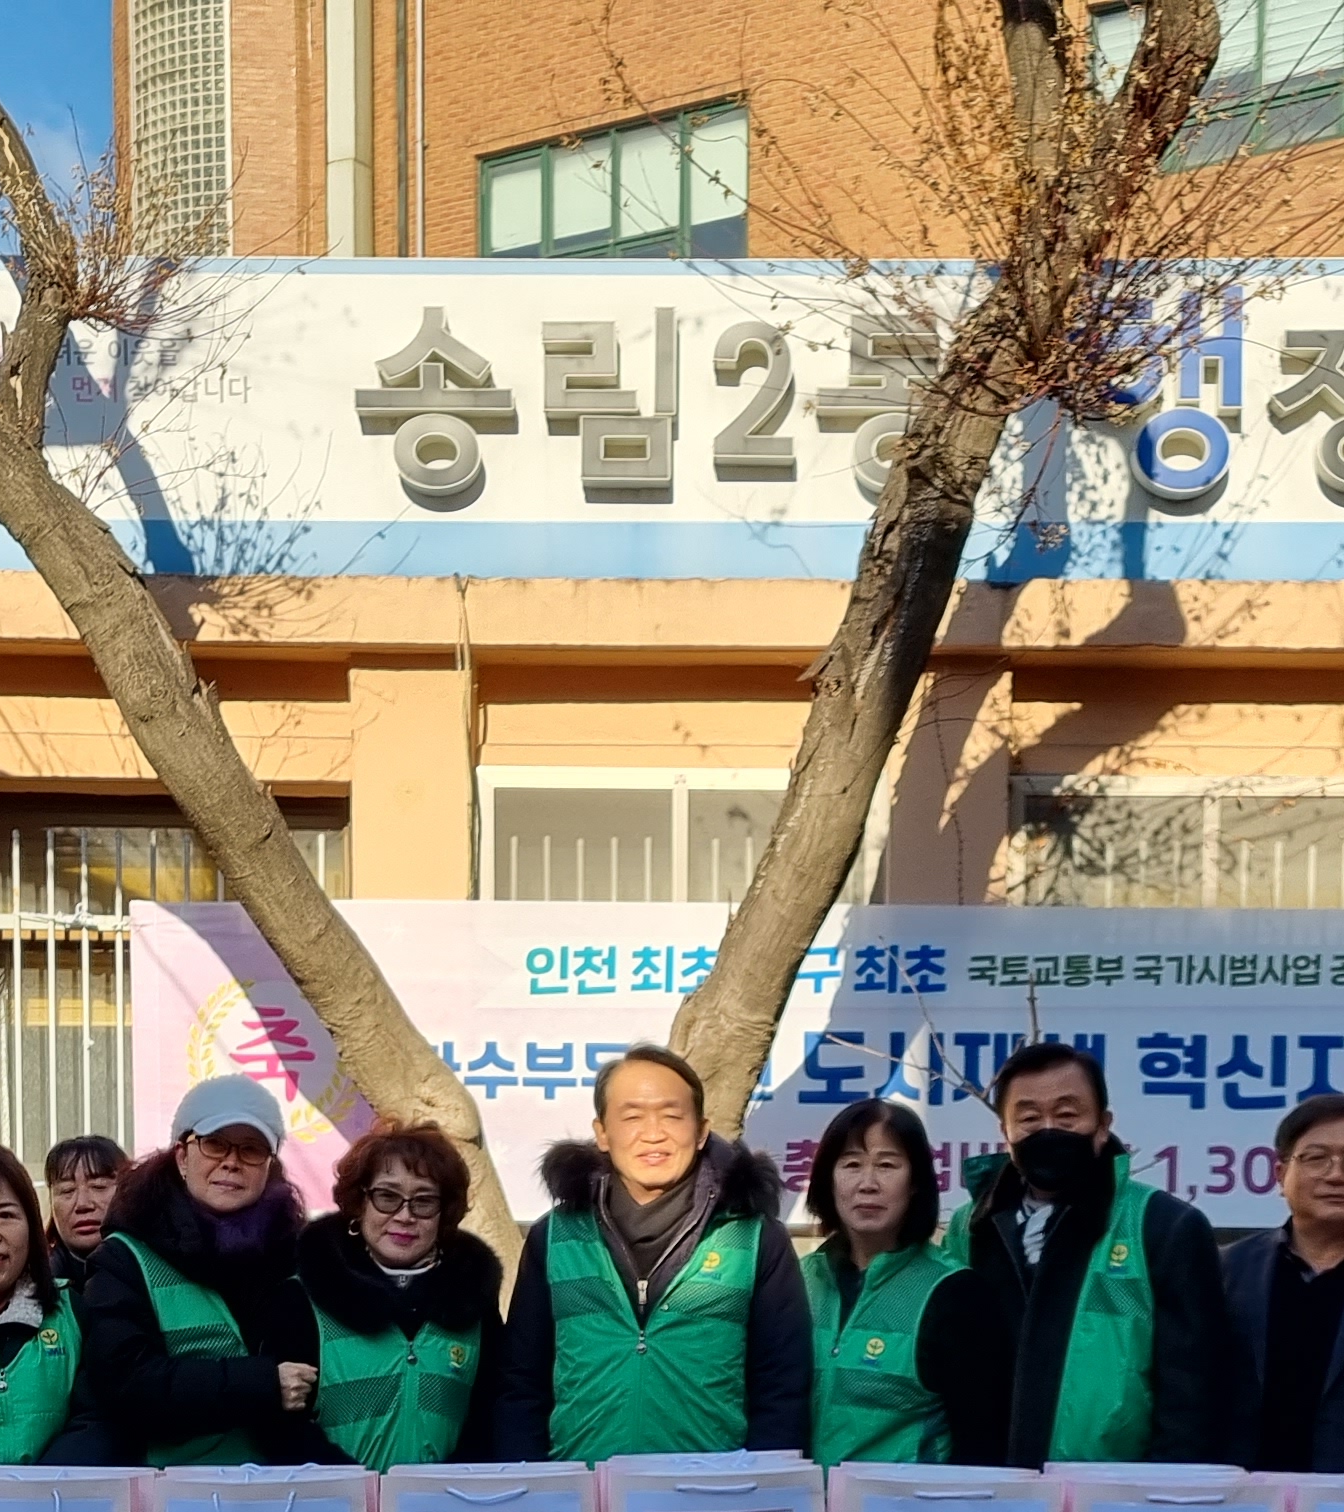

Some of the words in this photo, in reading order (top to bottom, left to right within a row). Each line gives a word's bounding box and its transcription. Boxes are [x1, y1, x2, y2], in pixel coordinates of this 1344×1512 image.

[108, 338, 177, 366] 이웃을
[72, 376, 118, 402] 먼저
[525, 945, 617, 996] 인천
[795, 946, 842, 994] 구
[853, 943, 947, 994] 최초
[967, 953, 1125, 986] 국토교통부
[1131, 953, 1322, 986] 국가시범사업
[229, 1006, 317, 1103] 축
[798, 1030, 1107, 1106] 도시재
